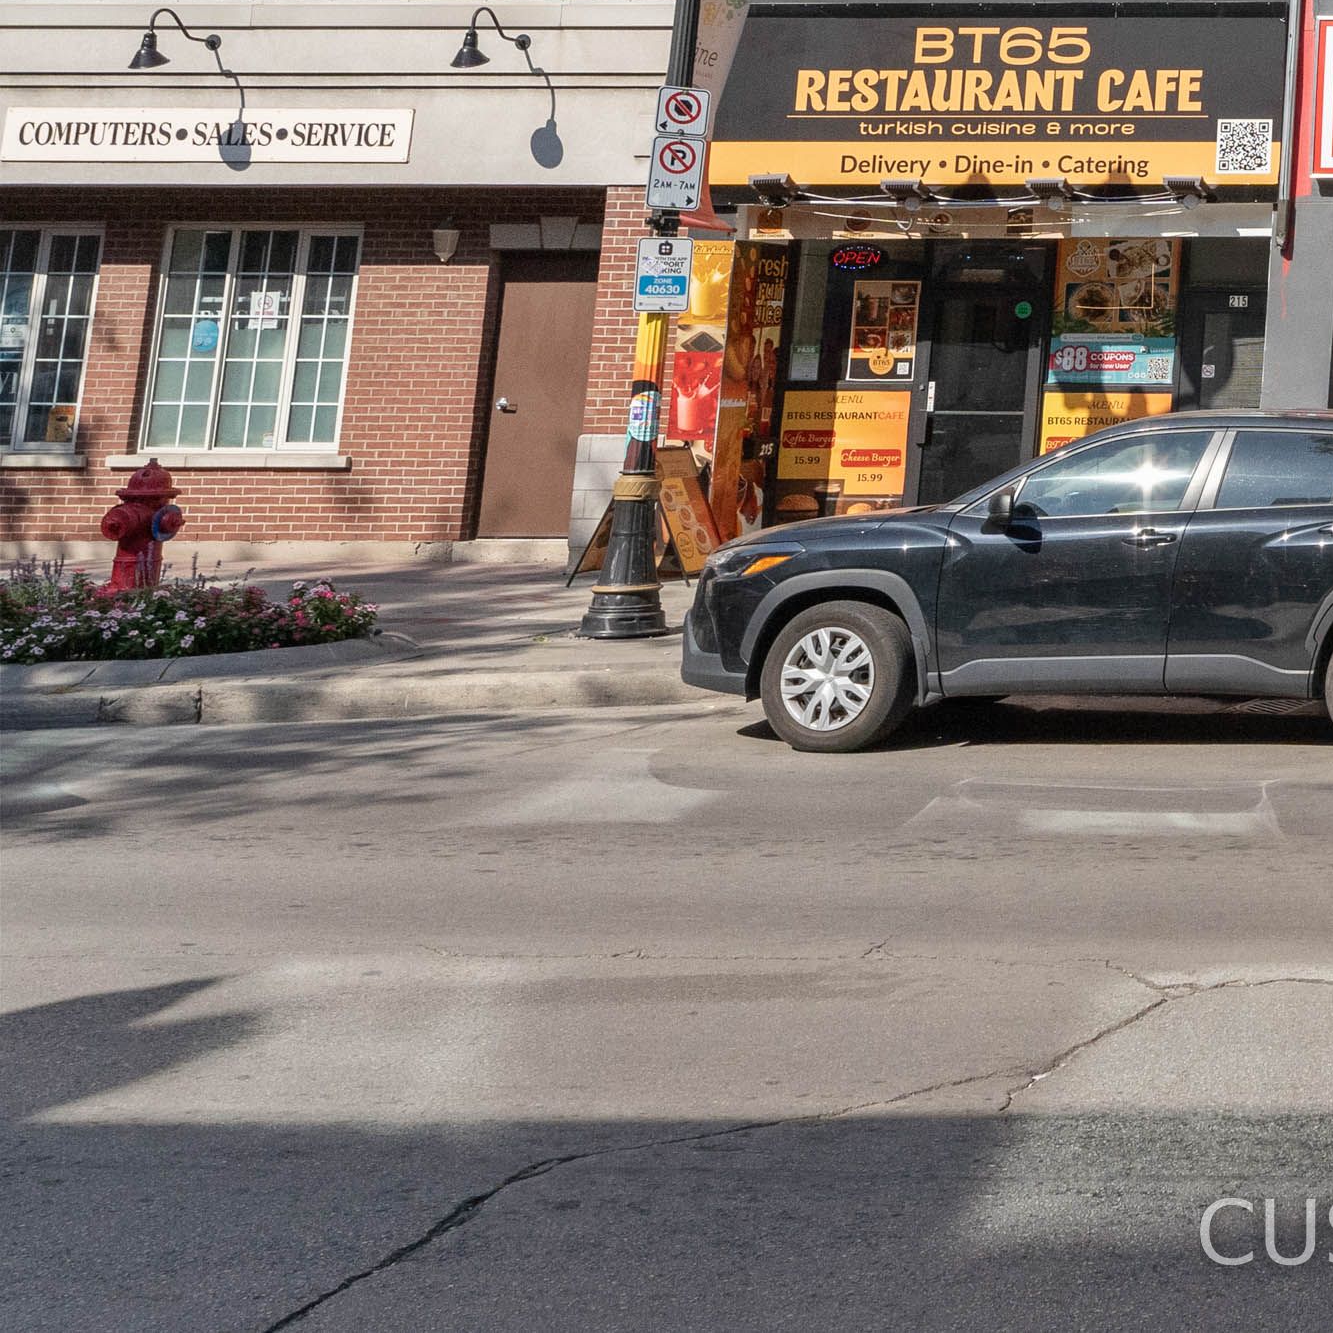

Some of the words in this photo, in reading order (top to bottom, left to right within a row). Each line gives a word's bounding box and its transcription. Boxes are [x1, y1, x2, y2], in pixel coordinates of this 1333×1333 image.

[913, 26, 1092, 65] BT65
[794, 69, 1083, 113] RESTAURANT
[1096, 69, 1203, 112] CAFE
[19, 121, 173, 147] COMPUTERS
[191, 121, 273, 147] SALES
[290, 121, 396, 147] SERVICE
[859, 120, 943, 135] turkish
[951, 120, 1036, 135] cuisine
[1046, 121, 1060, 135] &
[1069, 123, 1135, 135] more
[840, 153, 931, 177] Delivery
[954, 153, 1033, 175] Dine-in
[1057, 153, 1149, 177] Catering
[832, 251, 881, 265] OPEN
[645, 284, 680, 294] 40630
[1230, 296, 1248, 306] 215
[1055, 346, 1088, 370] $88
[1090, 353, 1134, 361] COUPONS
[787, 411, 811, 420] BT65
[1047, 417, 1072, 425] BT65
[759, 443, 773, 457] 215
[794, 456, 821, 464] 15.99
[841, 450, 870, 462] Cheese
[871, 453, 900, 467] Burger
[857, 473, 883, 482] 15.99
